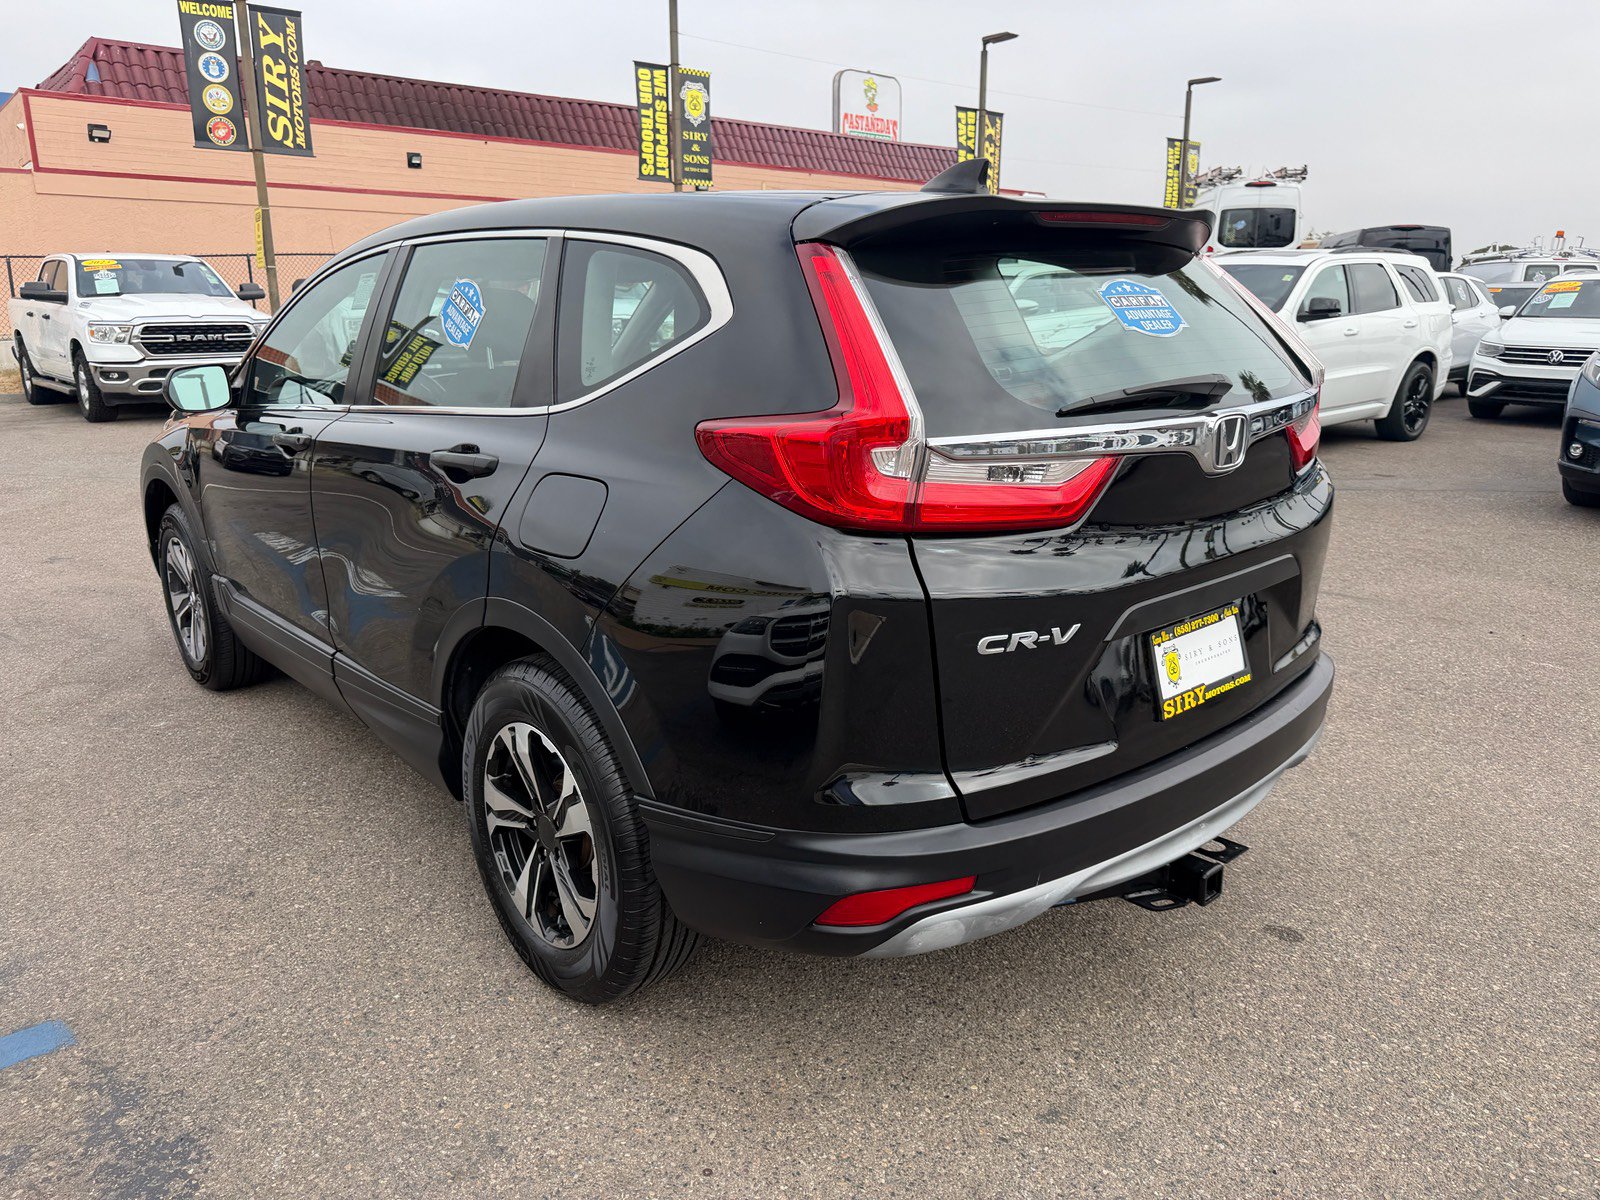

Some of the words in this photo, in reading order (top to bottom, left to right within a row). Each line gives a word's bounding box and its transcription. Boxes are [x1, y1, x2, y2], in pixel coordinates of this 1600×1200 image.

[179, 1, 233, 19] WELCOME
[258, 12, 294, 148] SIRY
[638, 68, 652, 104] OUR
[653, 70, 666, 97] WE
[641, 107, 654, 176] TROOPS
[655, 100, 670, 179] SUPPORT
[683, 131, 708, 142] SIRY
[958, 111, 966, 147] PAY
[966, 111, 976, 150] BUY
[683, 154, 710, 164] SONS
[452, 290, 479, 327] CARFAX
[1108, 295, 1169, 308] CARFAX
[1124, 309, 1174, 320] ADVANTAGE
[445, 318, 462, 342] DEALER
[446, 304, 472, 336] ADVANTAGE
[1140, 320, 1175, 330] DEALER
[1191, 613, 1219, 630] 277-7300
[977, 623, 1082, 655] CR-V
[1184, 648, 1202, 660] SIRY
[1218, 634, 1238, 648] SONS
